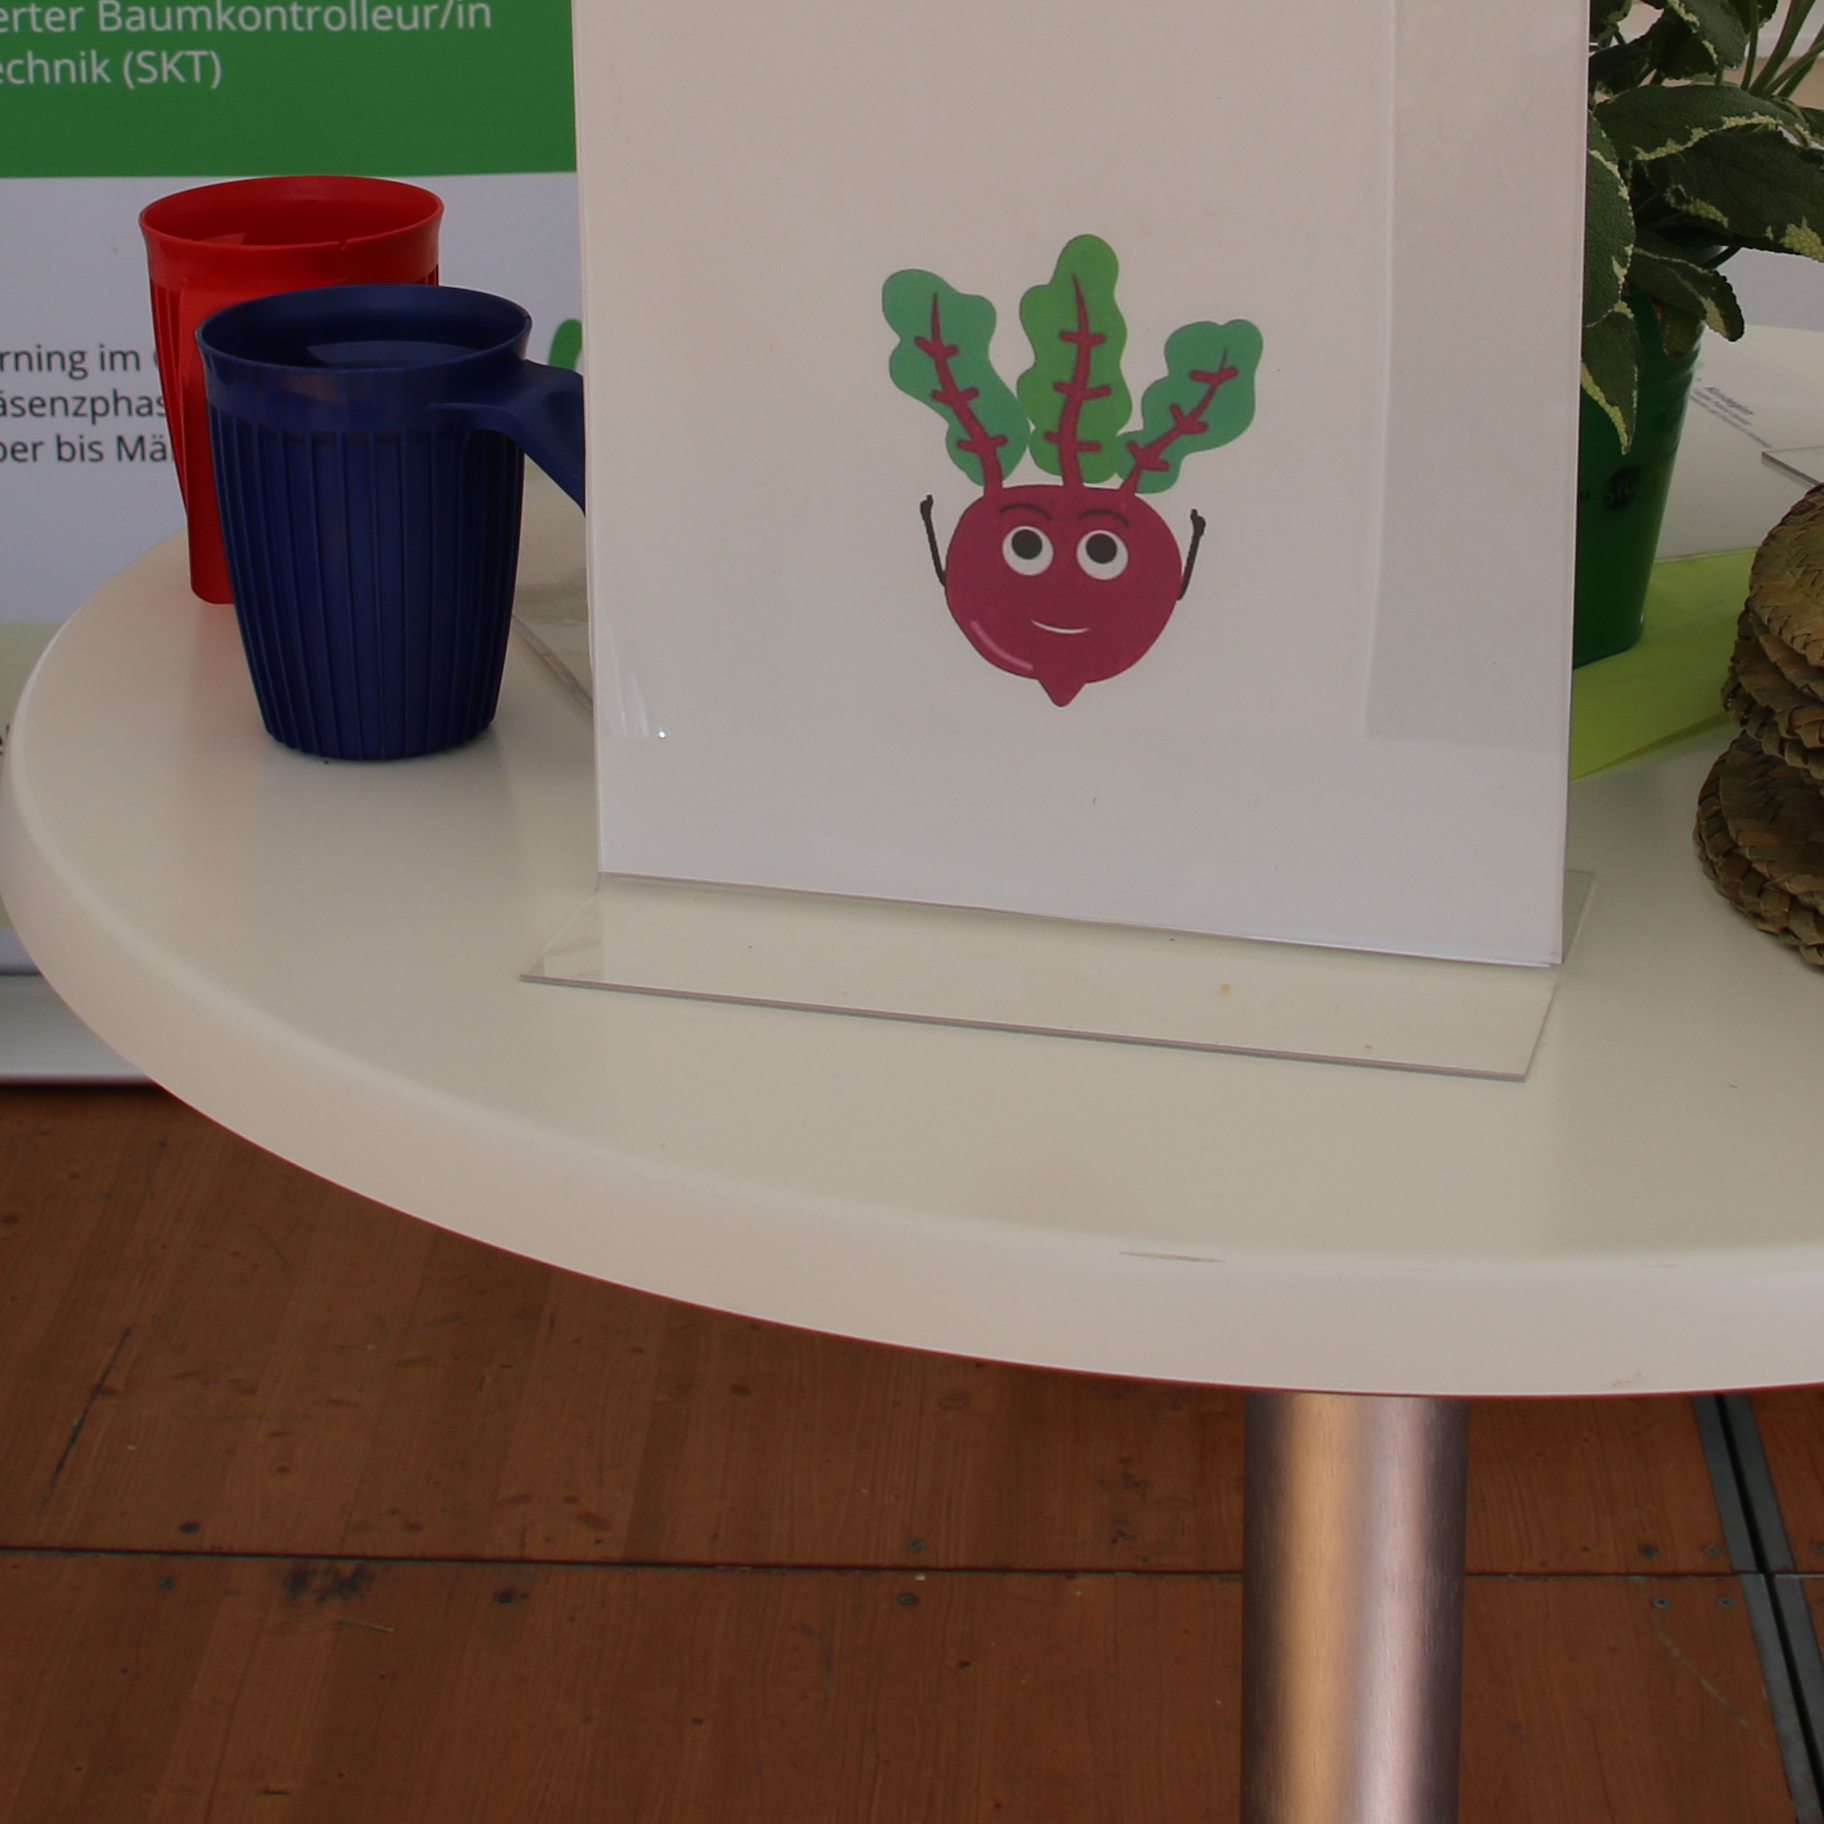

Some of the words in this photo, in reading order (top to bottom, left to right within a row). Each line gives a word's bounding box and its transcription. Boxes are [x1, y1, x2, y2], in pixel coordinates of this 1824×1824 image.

[123, 50, 221, 89] (SKT)
[100, 344, 140, 371] im
[56, 434, 104, 462] bis
[116, 434, 177, 462] Mä
